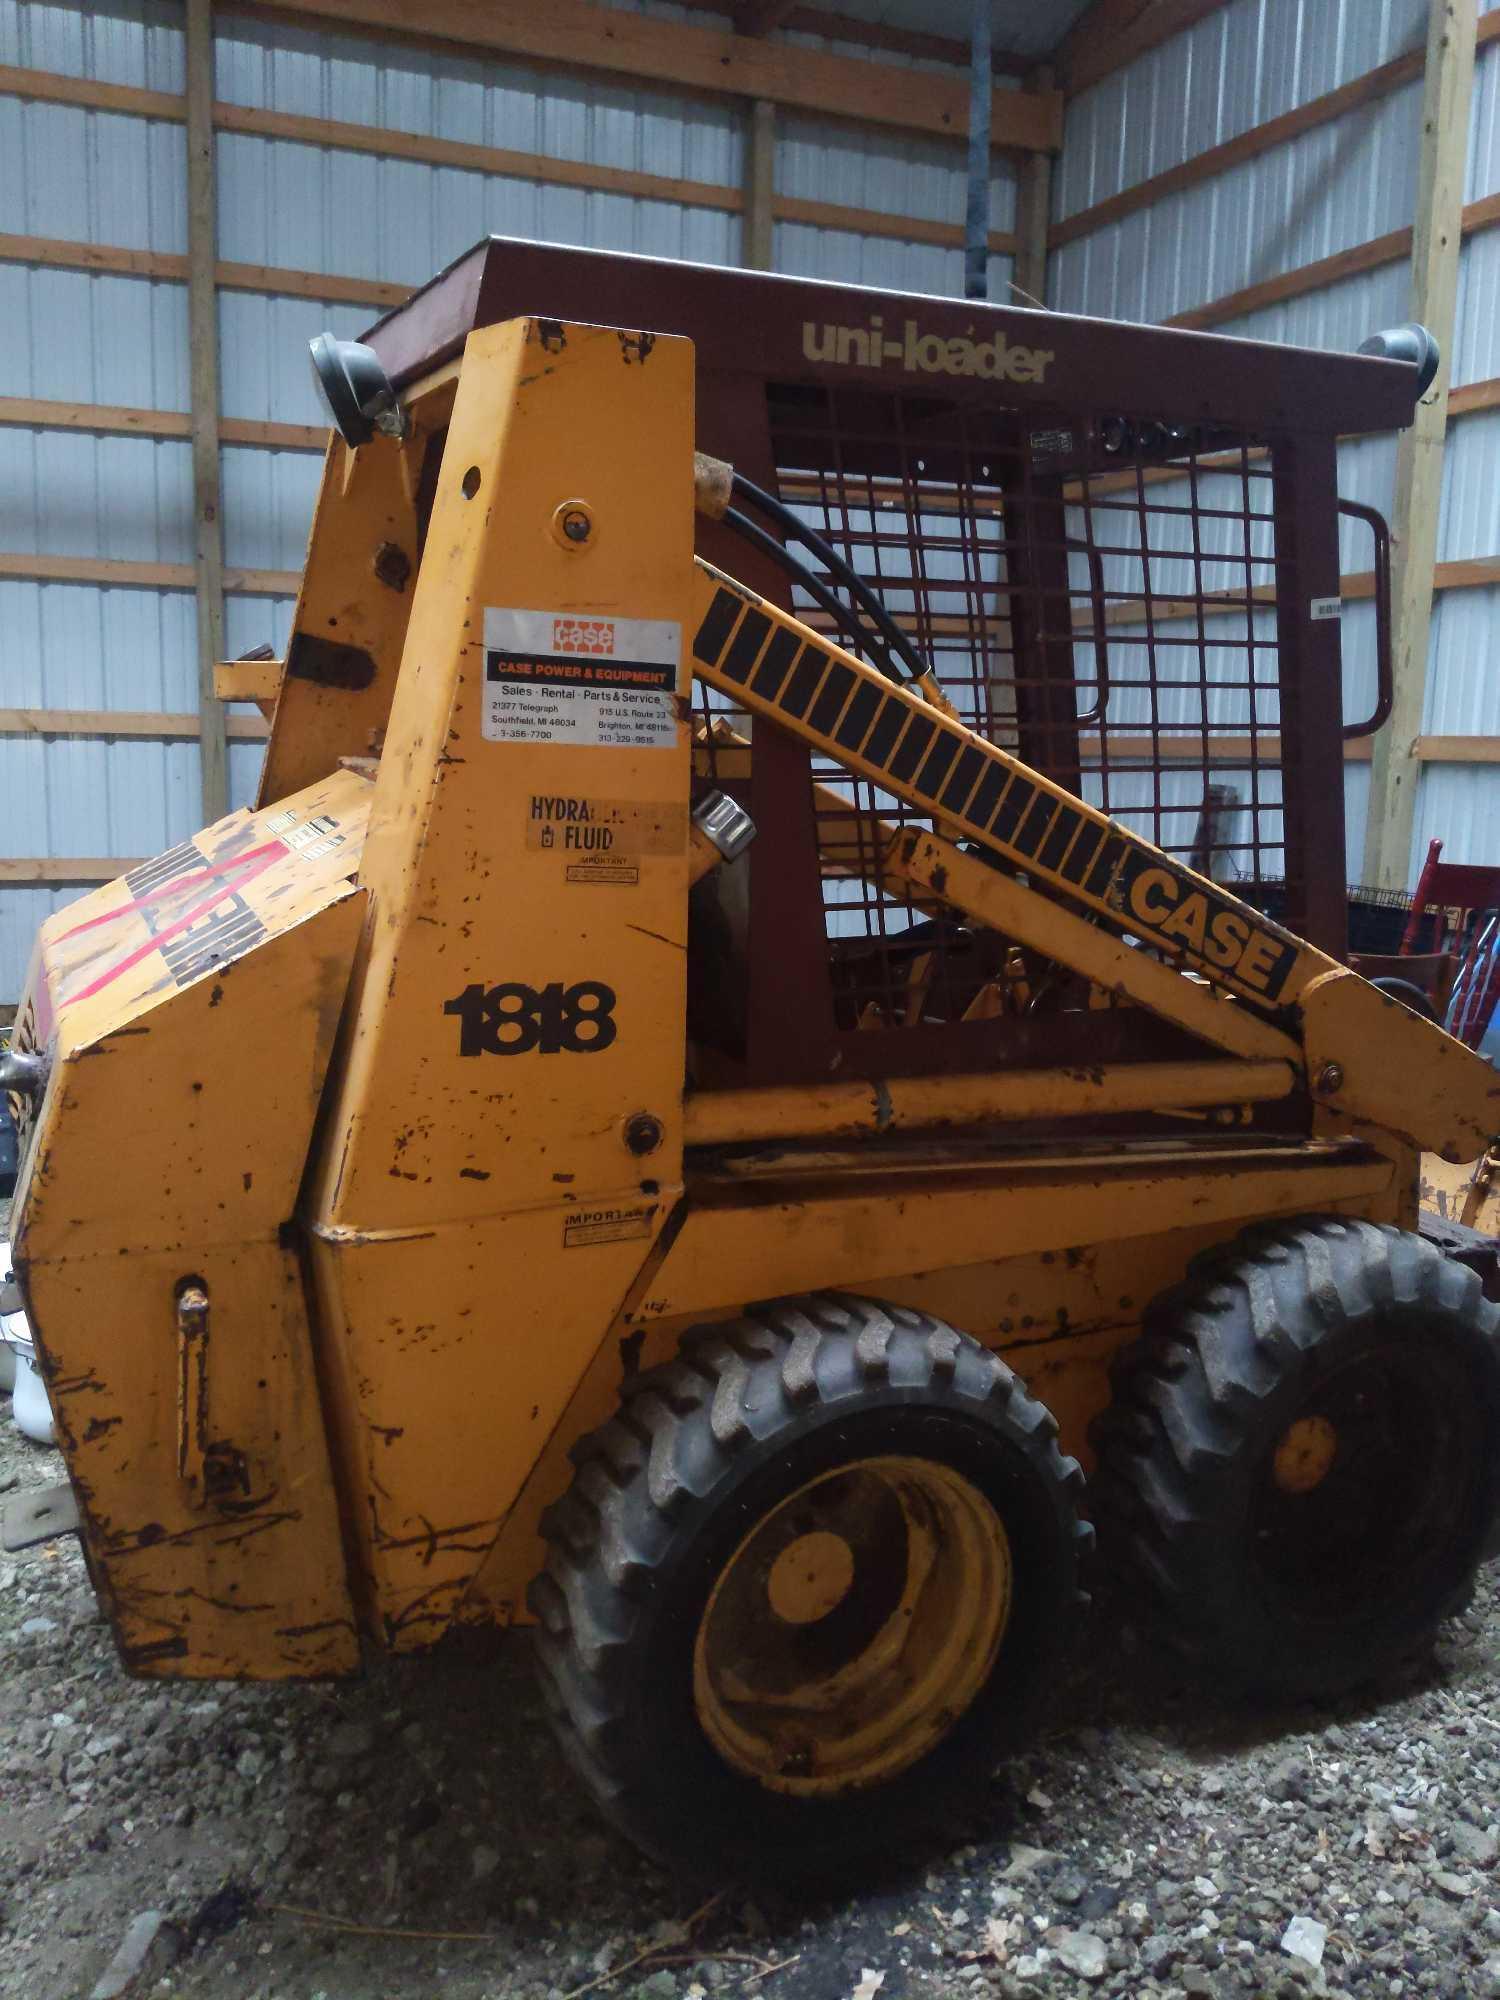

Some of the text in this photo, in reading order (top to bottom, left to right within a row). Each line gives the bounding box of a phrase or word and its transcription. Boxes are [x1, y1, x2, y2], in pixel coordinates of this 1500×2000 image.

[803, 316, 1055, 384] uni-loader
[498, 662, 667, 684] CASE POWER & EQUIPMENT
[502, 685, 661, 704] Sales Rental Parts & Service
[519, 703, 559, 714] Telegraph
[632, 709, 654, 719] Route
[538, 717, 547, 726] MI
[532, 797, 593, 821] HYDRA
[565, 826, 613, 850] FLUID
[1130, 868, 1286, 993] CASE
[443, 980, 617, 1056] 1818
